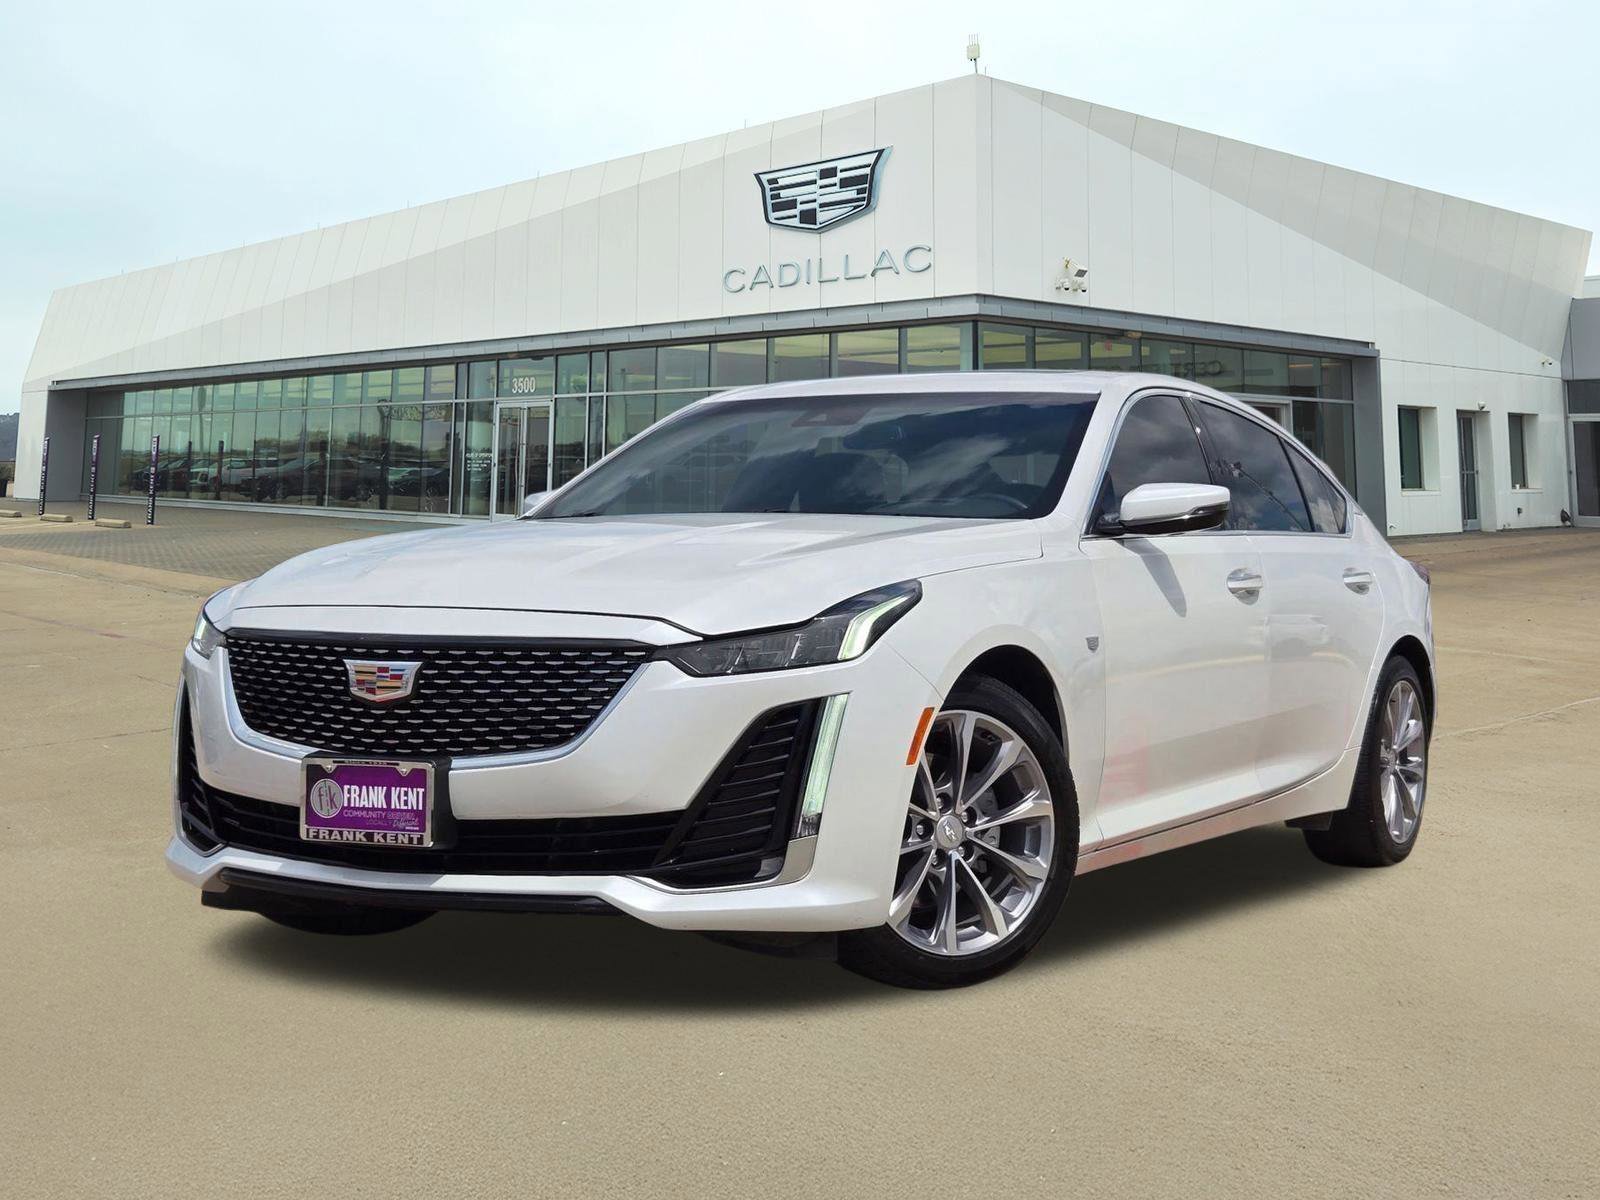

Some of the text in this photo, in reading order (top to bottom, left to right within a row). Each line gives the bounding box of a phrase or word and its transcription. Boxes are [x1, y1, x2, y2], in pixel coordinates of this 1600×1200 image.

[723, 245, 932, 293] CADILLAC
[511, 377, 536, 394] 3500
[343, 785, 425, 810] FRANK KENT
[343, 809, 386, 818] COMMUNITY
[308, 828, 421, 845] FRANK KENT
